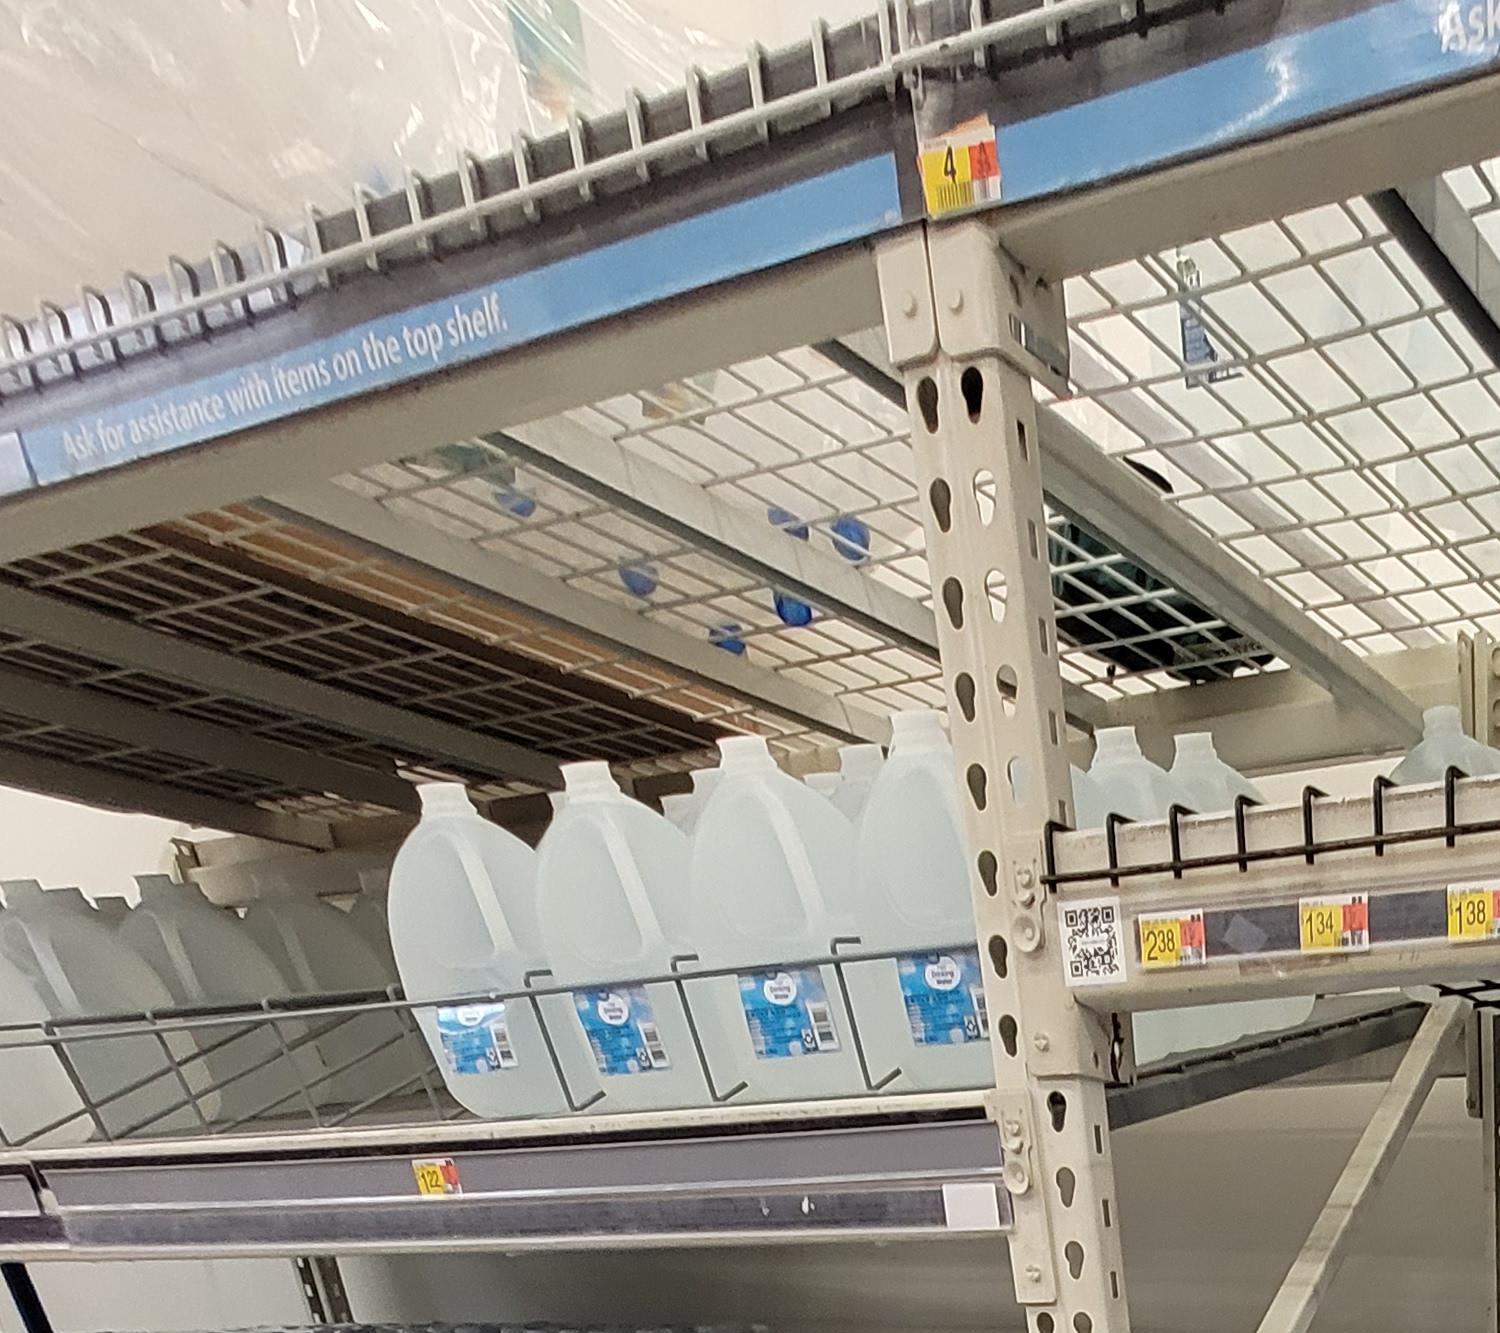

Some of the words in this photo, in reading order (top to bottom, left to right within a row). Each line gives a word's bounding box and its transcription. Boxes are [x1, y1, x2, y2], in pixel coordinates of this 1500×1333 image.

[63, 429, 99, 462] Ask
[100, 417, 126, 453] for
[130, 394, 225, 444] assistance
[225, 373, 273, 416] with
[271, 358, 332, 401] items
[334, 351, 363, 381] on
[362, 333, 402, 372] the
[403, 323, 444, 362] top
[447, 291, 508, 346] shelf.
